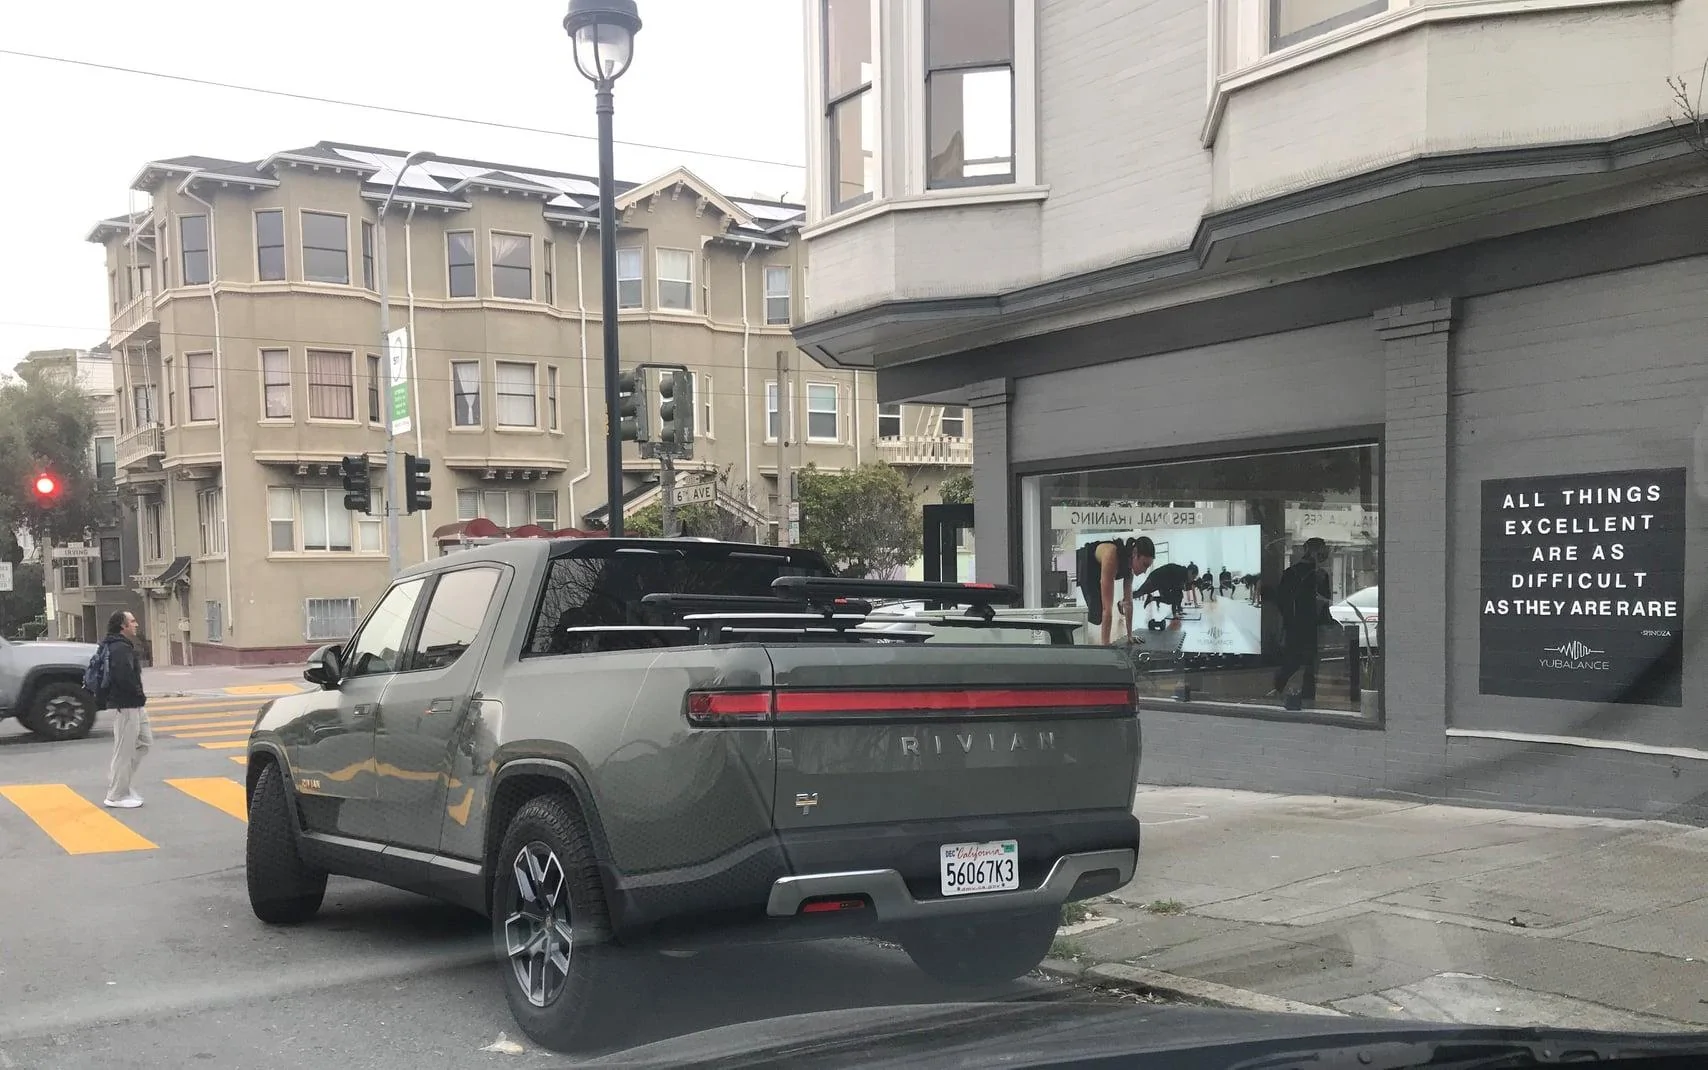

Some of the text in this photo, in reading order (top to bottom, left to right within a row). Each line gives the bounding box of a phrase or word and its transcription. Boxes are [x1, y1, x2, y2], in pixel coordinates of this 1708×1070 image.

[693, 487, 711, 500] AVE
[1502, 485, 1661, 508] ALL THINGS
[1505, 514, 1654, 535] EXCELLENT
[1532, 544, 1624, 562] ARE AS
[1512, 573, 1647, 589] DIFFICULT
[1484, 600, 1677, 617] AS THEY ARE RARE
[1539, 659, 1610, 670] YUBALANCE
[901, 732, 1055, 756] RIVIAN
[945, 850, 956, 858] DEC
[957, 847, 1004, 861] California
[946, 859, 1014, 887] 56067K3
